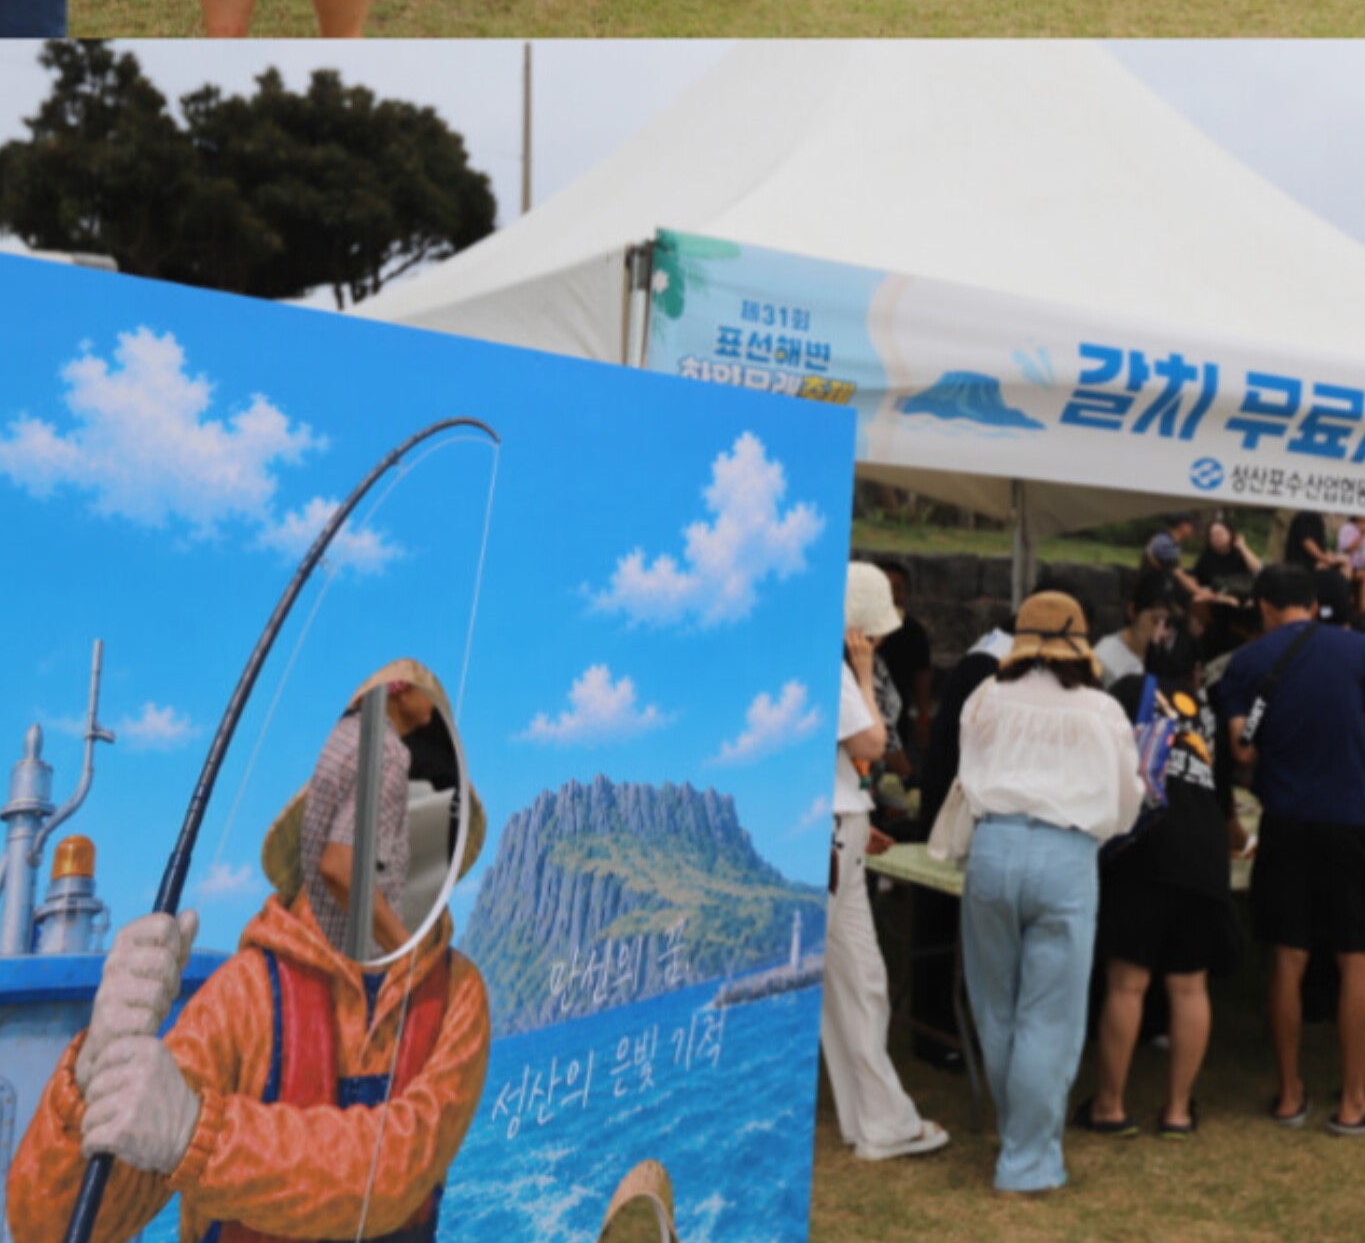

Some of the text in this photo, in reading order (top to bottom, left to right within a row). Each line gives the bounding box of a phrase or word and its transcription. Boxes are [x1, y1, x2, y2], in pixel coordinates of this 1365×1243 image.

[715, 325, 831, 371] 표선해변
[742, 300, 810, 331] 제31회
[1059, 342, 1219, 441] 갈치
[492, 1008, 726, 1140] 성산의 은빛 기적
